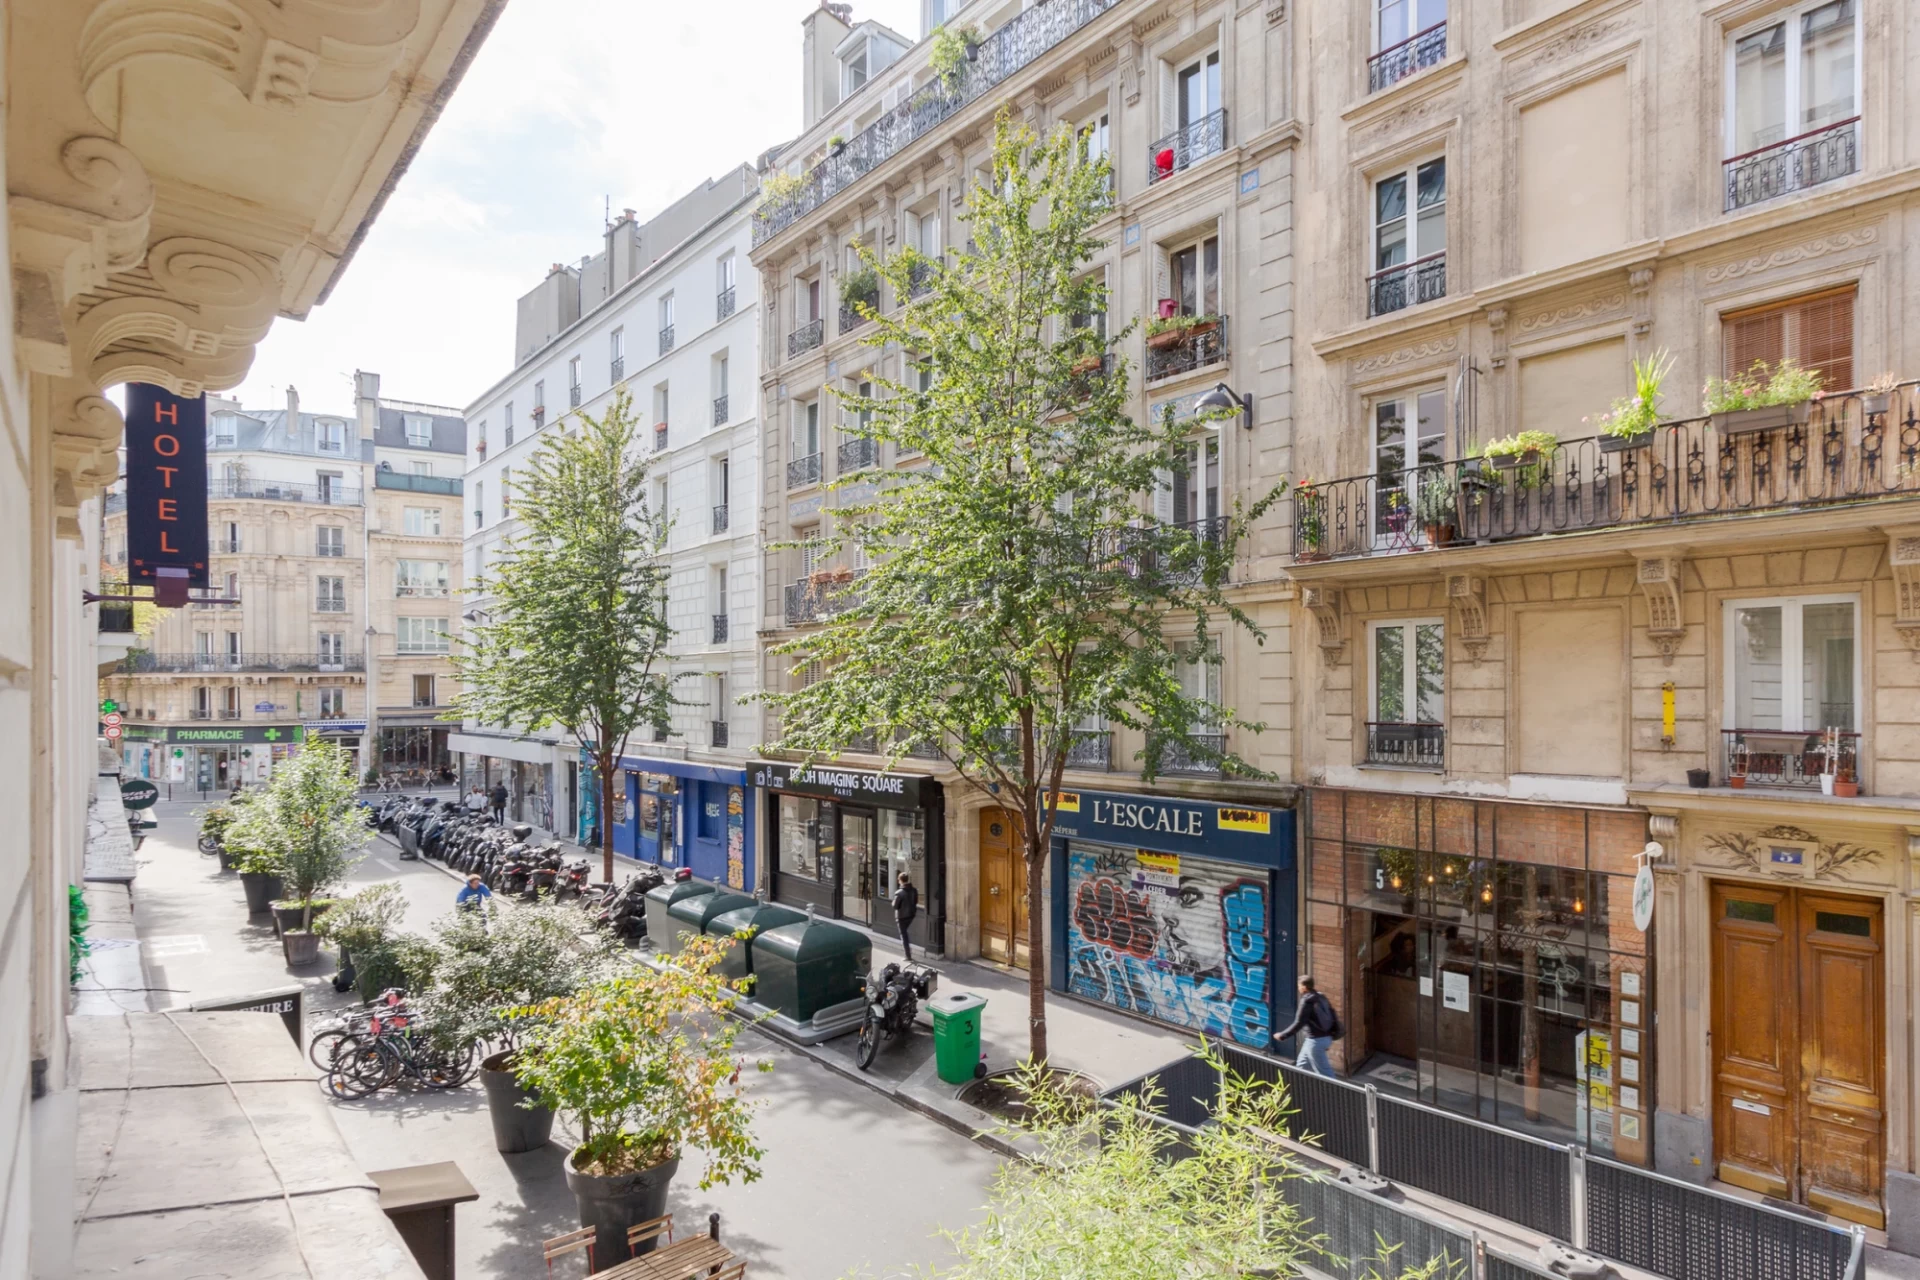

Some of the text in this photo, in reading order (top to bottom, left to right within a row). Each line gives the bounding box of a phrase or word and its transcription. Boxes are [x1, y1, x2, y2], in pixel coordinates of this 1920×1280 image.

[153, 401, 181, 553] HOTEL
[176, 730, 244, 740] PHARMACIE
[818, 770, 859, 789] IMAGING
[862, 777, 904, 794] SQUARE
[834, 788, 852, 796] PARIS
[1093, 800, 1203, 837] L'ESCALE
[1779, 851, 1793, 863] 5
[1376, 869, 1384, 889] 5
[965, 1020, 974, 1035] 3
